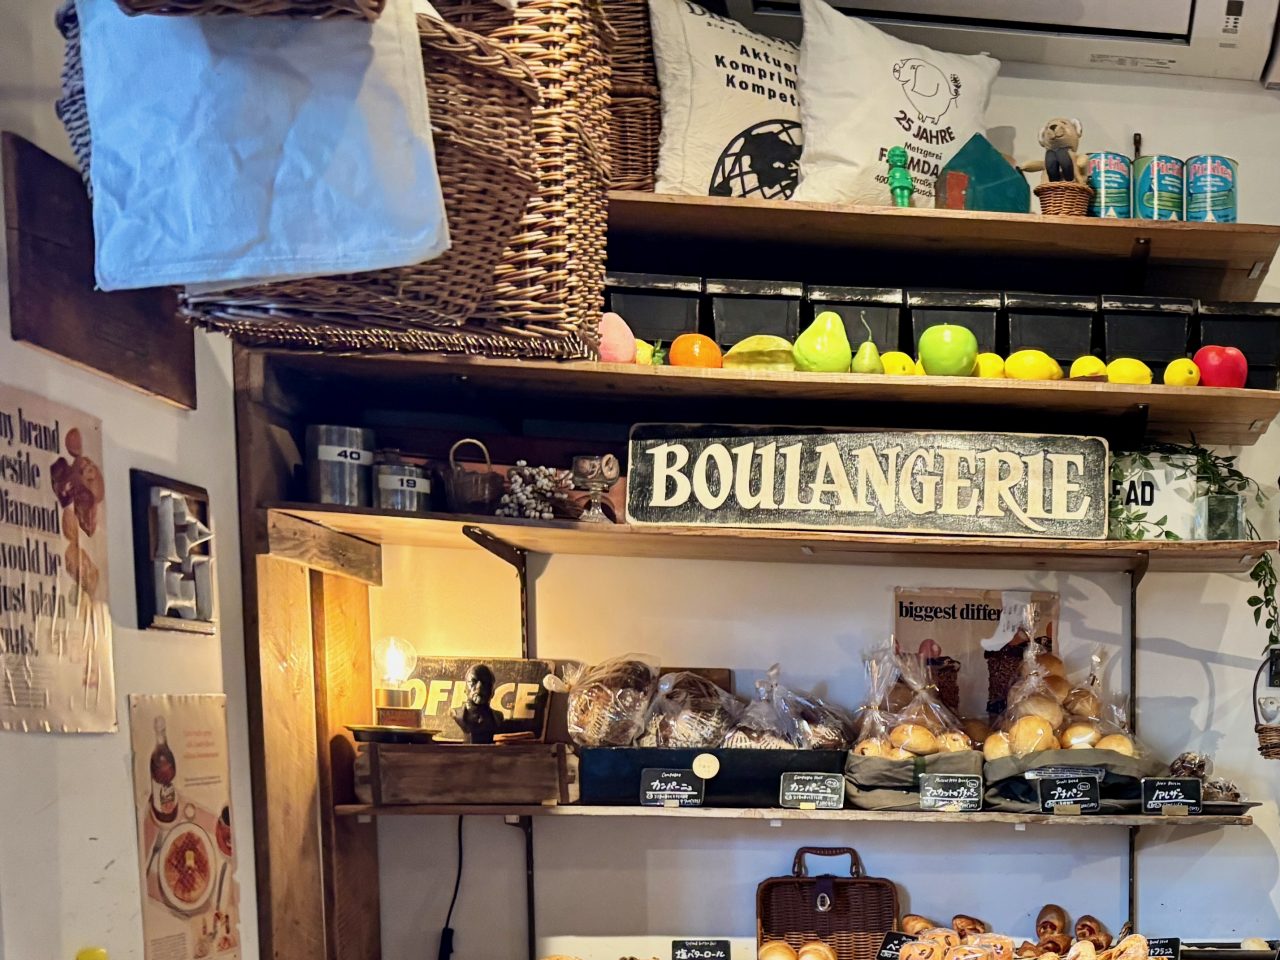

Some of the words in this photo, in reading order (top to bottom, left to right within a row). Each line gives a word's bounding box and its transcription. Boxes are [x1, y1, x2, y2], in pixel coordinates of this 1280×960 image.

[894, 110, 915, 133] 25
[912, 126, 956, 145] JAHRE
[1189, 162, 1233, 181] Pickles
[18, 408, 60, 454] brand
[337, 450, 361, 461] 40
[399, 478, 417, 489] 19
[645, 441, 1092, 532] BOULANGERIE
[899, 601, 958, 622] biggest
[651, 780, 693, 792] カンパーニュ
[790, 782, 832, 793] カンパーニュ
[1050, 787, 1083, 800] プチパン
[675, 949, 726, 960] 塩バターロール
